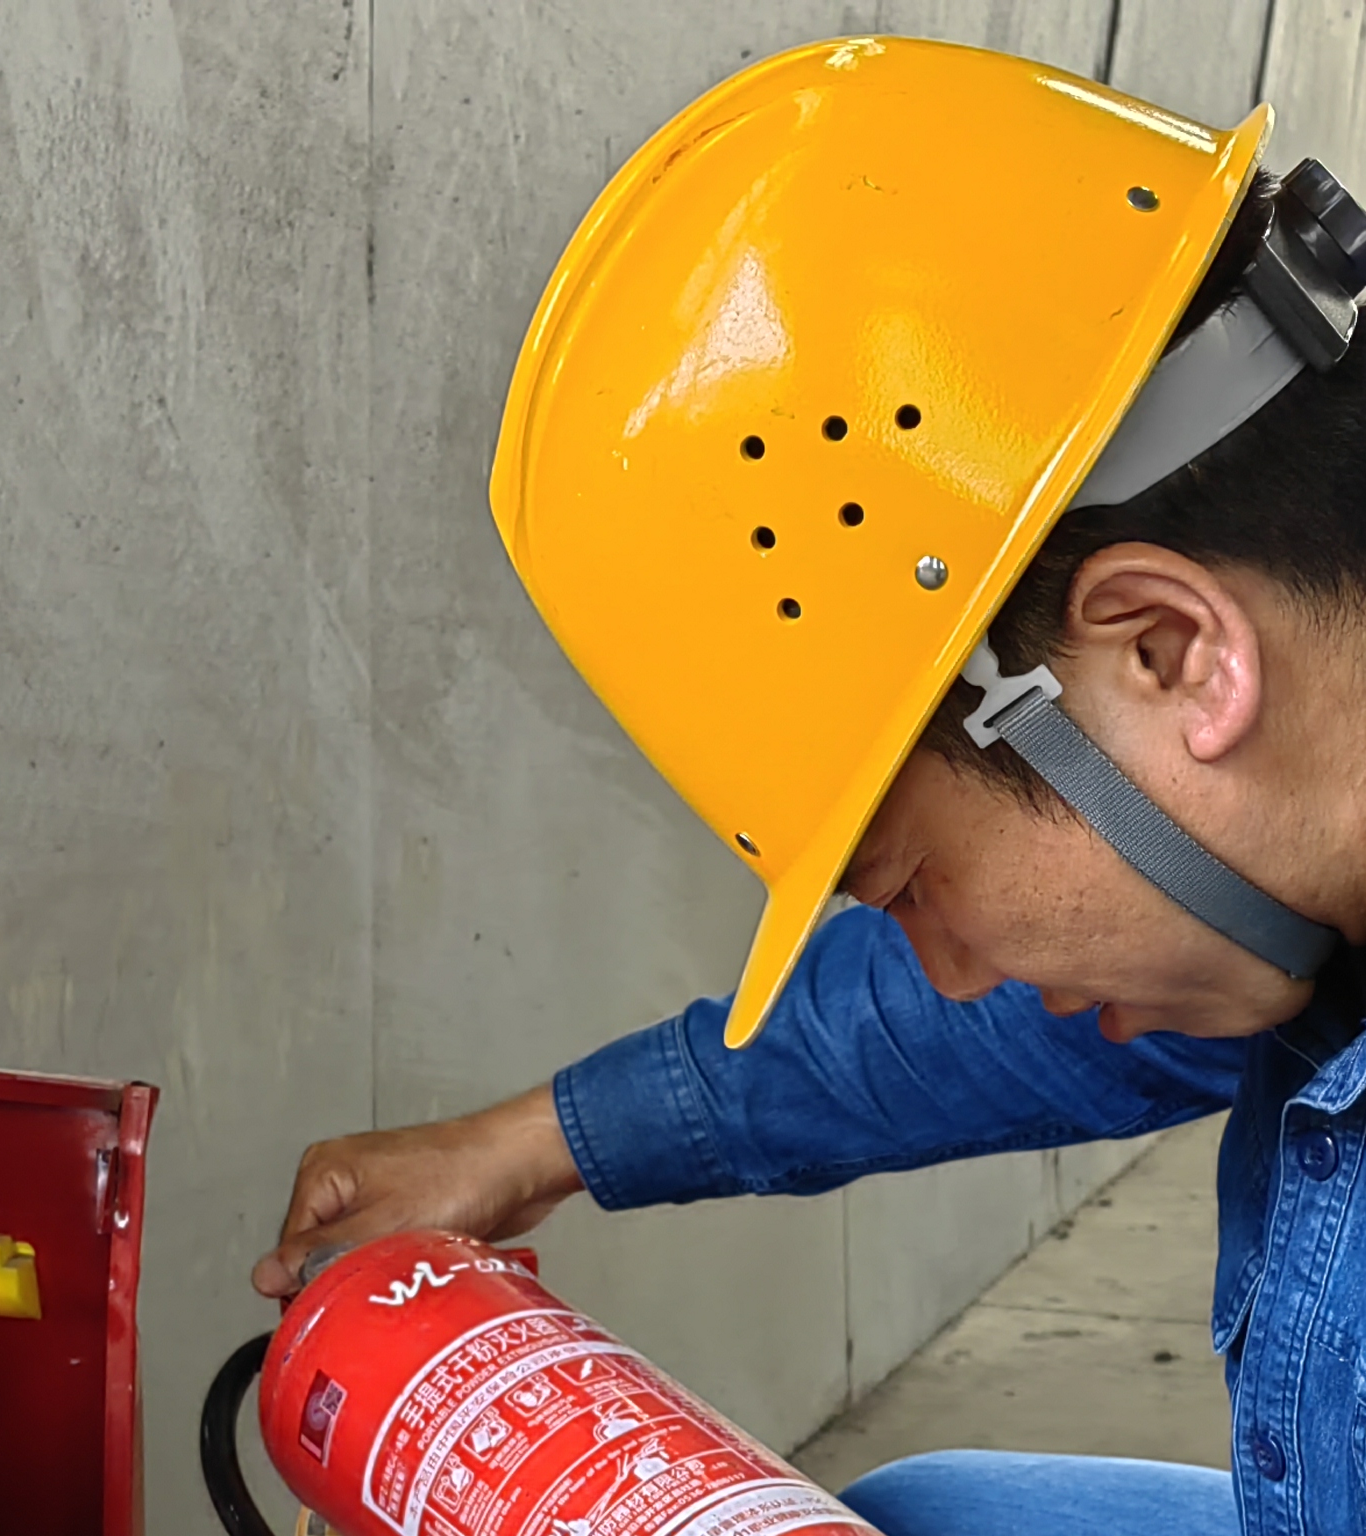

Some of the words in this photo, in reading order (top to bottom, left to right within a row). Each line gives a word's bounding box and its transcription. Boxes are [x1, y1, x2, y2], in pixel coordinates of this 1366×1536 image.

[400, 1316, 559, 1429] 手提式干粉灭火器
[416, 1399, 458, 1450] PORTABLE
[455, 1363, 499, 1400] POWDER
